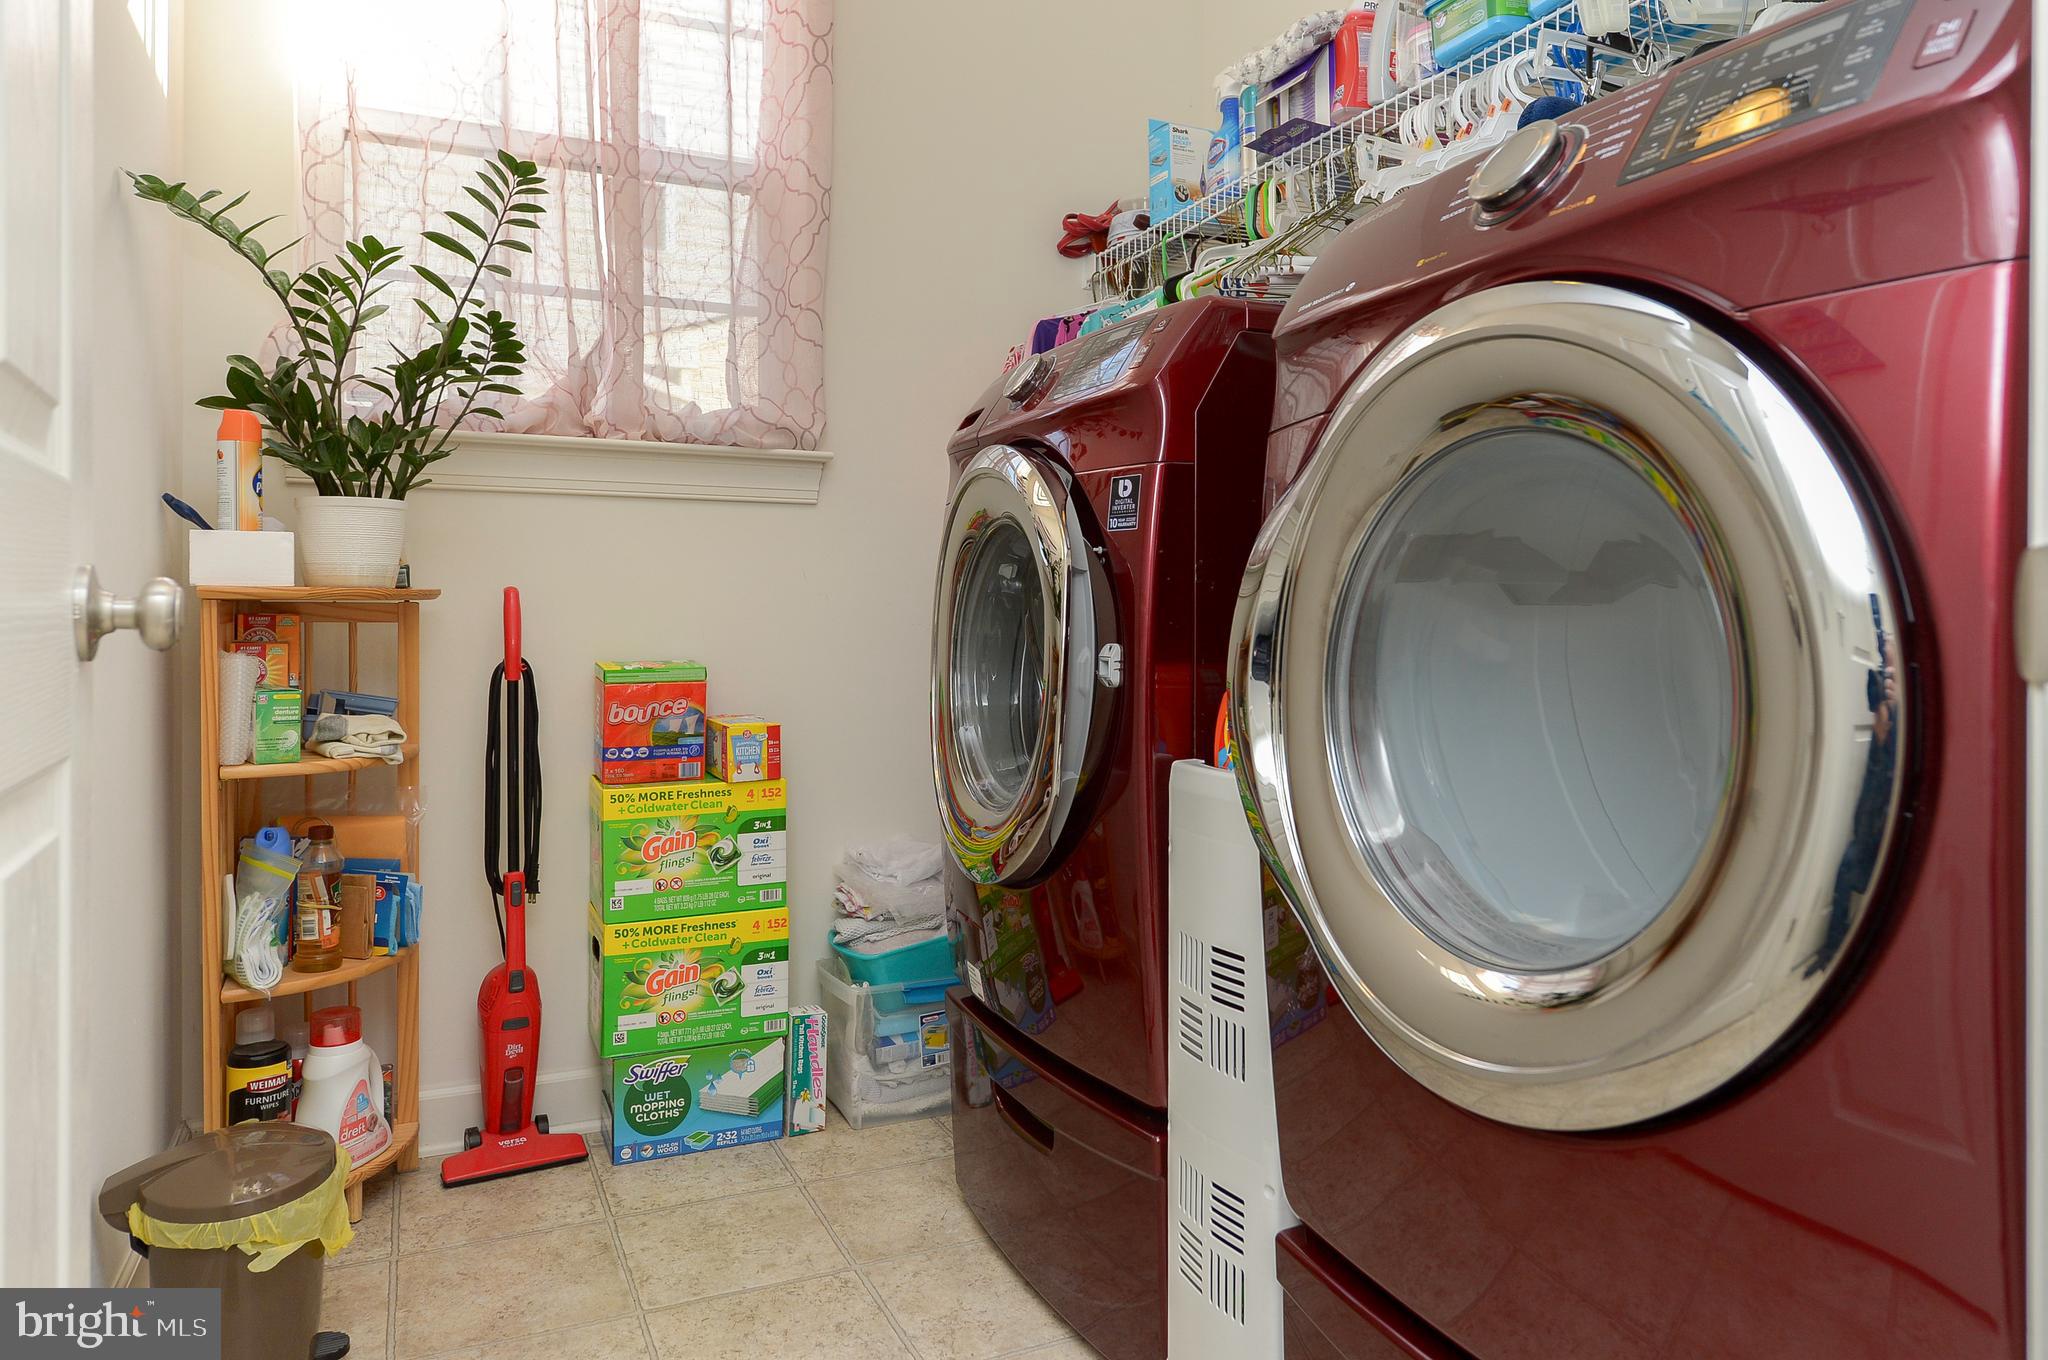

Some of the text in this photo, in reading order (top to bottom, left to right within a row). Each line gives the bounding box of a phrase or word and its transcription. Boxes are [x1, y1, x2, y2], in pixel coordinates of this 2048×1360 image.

[1172, 126, 1189, 135] Shark
[1110, 518, 1118, 528] 10
[608, 698, 689, 725] bounce
[735, 745, 761, 755] KITCHEN
[610, 788, 732, 804] 50% MORE Freshness
[746, 789, 754, 799] 4
[762, 787, 782, 798] 152
[627, 803, 689, 815] Coldwater
[690, 800, 723, 810] Clean
[641, 830, 697, 863] Gain
[658, 852, 696, 873] flings!
[614, 921, 737, 939] 50% MORE Freshness
[752, 920, 760, 930] 4
[767, 918, 787, 929] 152
[631, 937, 693, 949] Coldwater
[695, 932, 727, 942] Clean
[645, 962, 701, 997] Gain
[661, 985, 699, 1006] flings!
[755, 1003, 774, 1011] original
[505, 1046, 524, 1056] Devil
[805, 1016, 824, 1100] Handles
[623, 1060, 689, 1085] Swiffer
[250, 1075, 287, 1090] WEIMAN
[245, 1089, 290, 1106] FURNITURE
[644, 1090, 671, 1102] WET
[260, 1101, 280, 1110] WIPES
[630, 1098, 685, 1114] MOPPING
[635, 1108, 680, 1123] CLOTHS
[340, 1122, 366, 1141] dreft
[498, 1136, 528, 1146] versa
[716, 1139, 738, 1147] REFILLS
[656, 1146, 679, 1154] WOOD
